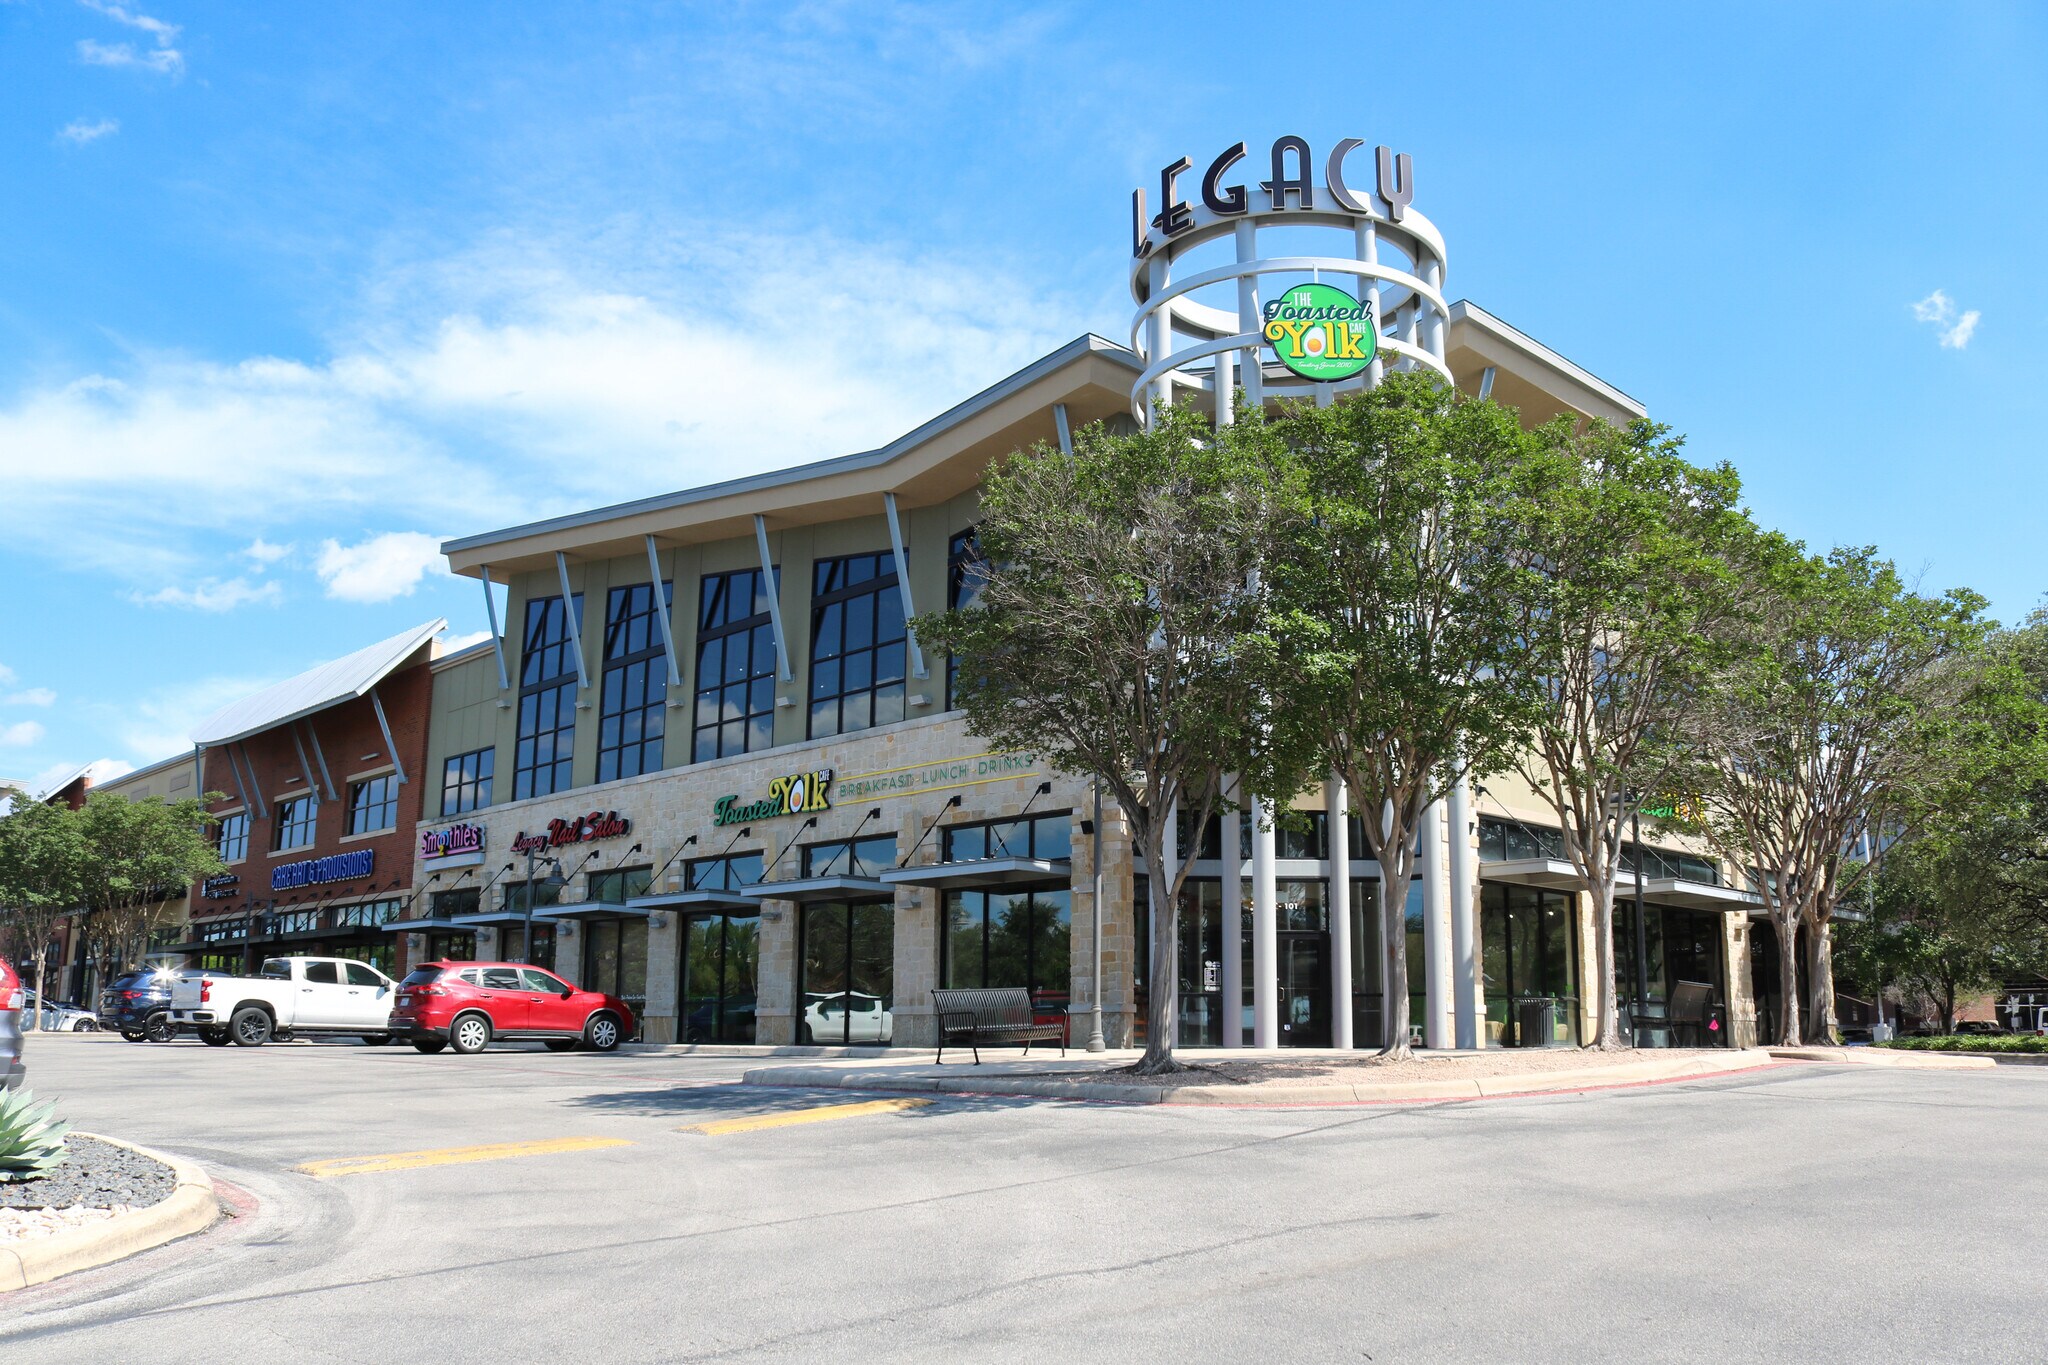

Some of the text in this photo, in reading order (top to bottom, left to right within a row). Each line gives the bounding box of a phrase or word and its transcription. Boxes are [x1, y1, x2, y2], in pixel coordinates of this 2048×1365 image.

[1132, 135, 1413, 259] LEGACY
[1264, 300, 1372, 321] Toasted
[1293, 292, 1312, 306] THE
[1265, 321, 1367, 359] Yolk
[1349, 322, 1366, 333] CAFE
[839, 753, 1034, 798] BREAKFAST LUNCH DRINKS
[713, 770, 831, 827] Toasted Yolk
[510, 811, 629, 856] Legacy Nail Salon
[271, 850, 372, 890] CAKE ART & PROVISIONS
[1284, 902, 1298, 910] 101
